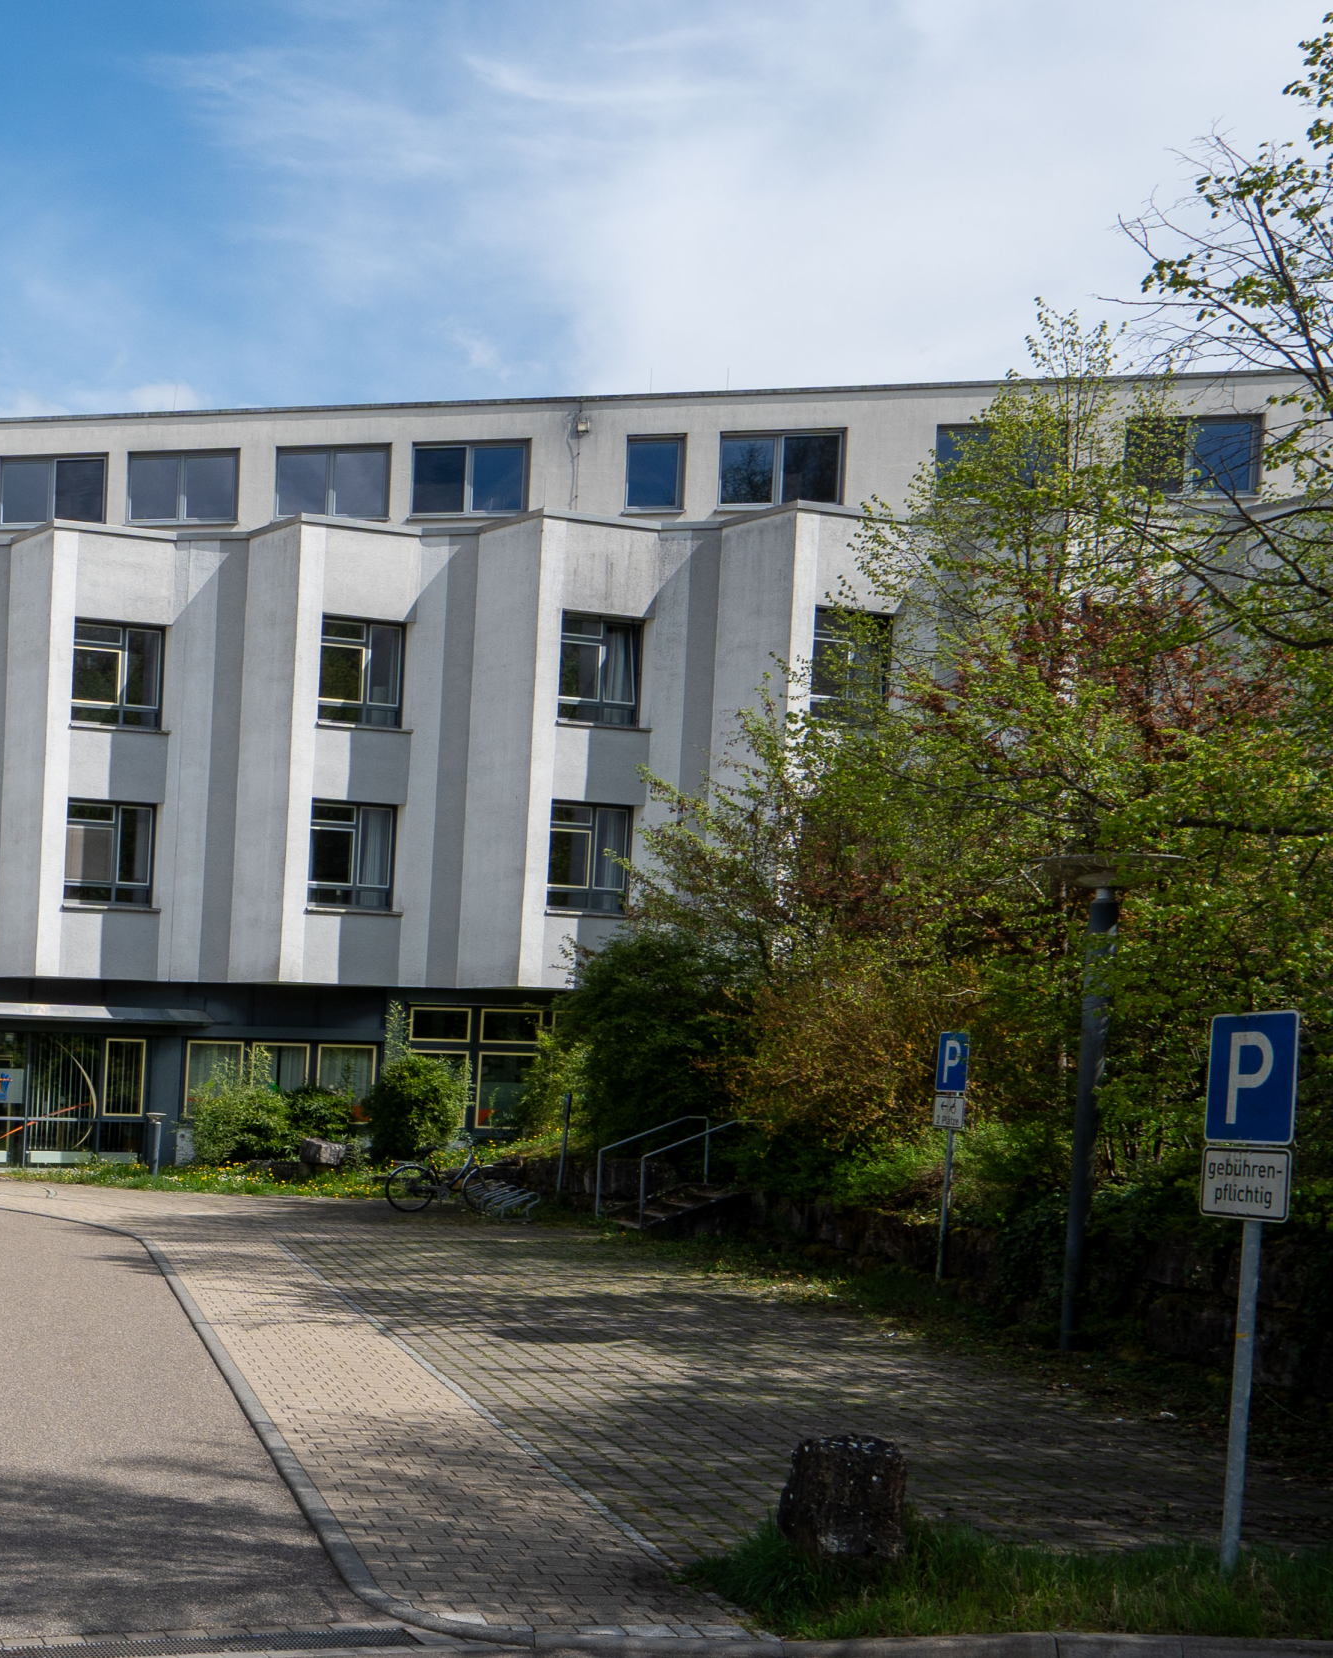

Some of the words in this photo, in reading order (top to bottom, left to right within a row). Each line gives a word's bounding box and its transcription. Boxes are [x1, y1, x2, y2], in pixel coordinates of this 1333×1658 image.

[942, 1040, 961, 1084] P
[1225, 1031, 1274, 1124] P
[1208, 1159, 1283, 1180] gebühren-
[1214, 1183, 1273, 1209] pflichtig
